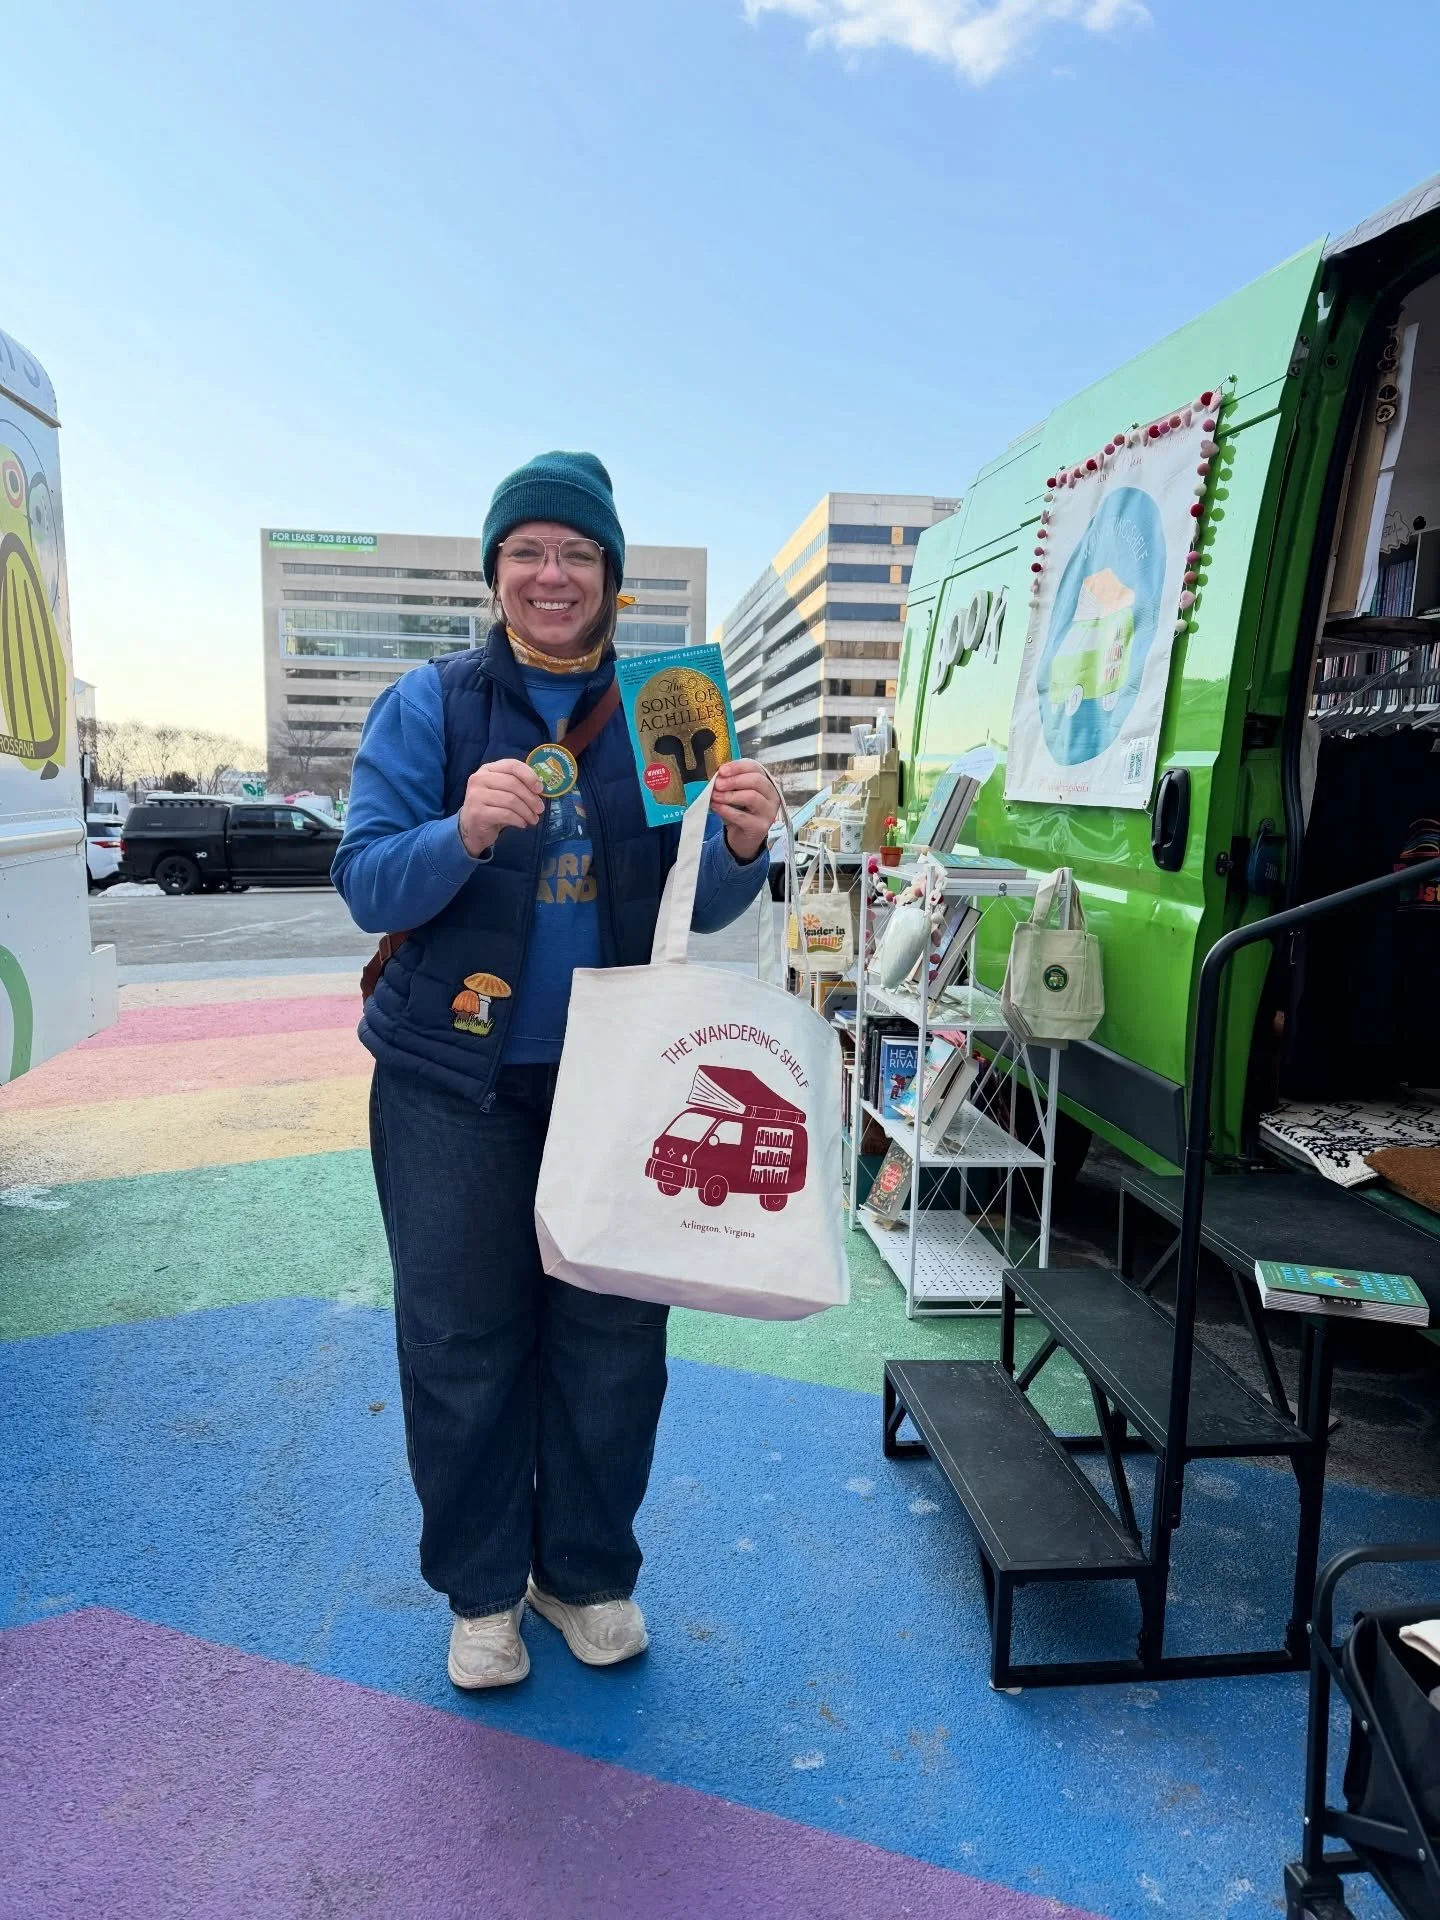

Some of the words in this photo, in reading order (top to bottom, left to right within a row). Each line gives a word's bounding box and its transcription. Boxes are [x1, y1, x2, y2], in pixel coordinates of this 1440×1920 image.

[272, 532, 289, 541] FOR
[292, 533, 315, 542] LEASE
[318, 534, 334, 543] 703
[336, 535, 351, 544] 821
[353, 536, 374, 545] 6900
[931, 586, 1009, 694] BOOK
[644, 657, 661, 665] YORK
[663, 653, 681, 662] TIMES
[682, 647, 717, 657] BESTSELLER
[641, 693, 689, 714] SONG
[694, 688, 715, 703] OF
[640, 703, 724, 732] ACHILLES
[836, 925, 846, 935] in
[660, 1037, 693, 1065] THE
[689, 1023, 781, 1055] WANDERING
[779, 1049, 810, 1089] SHELF
[724, 1225, 755, 1239] Virginia
